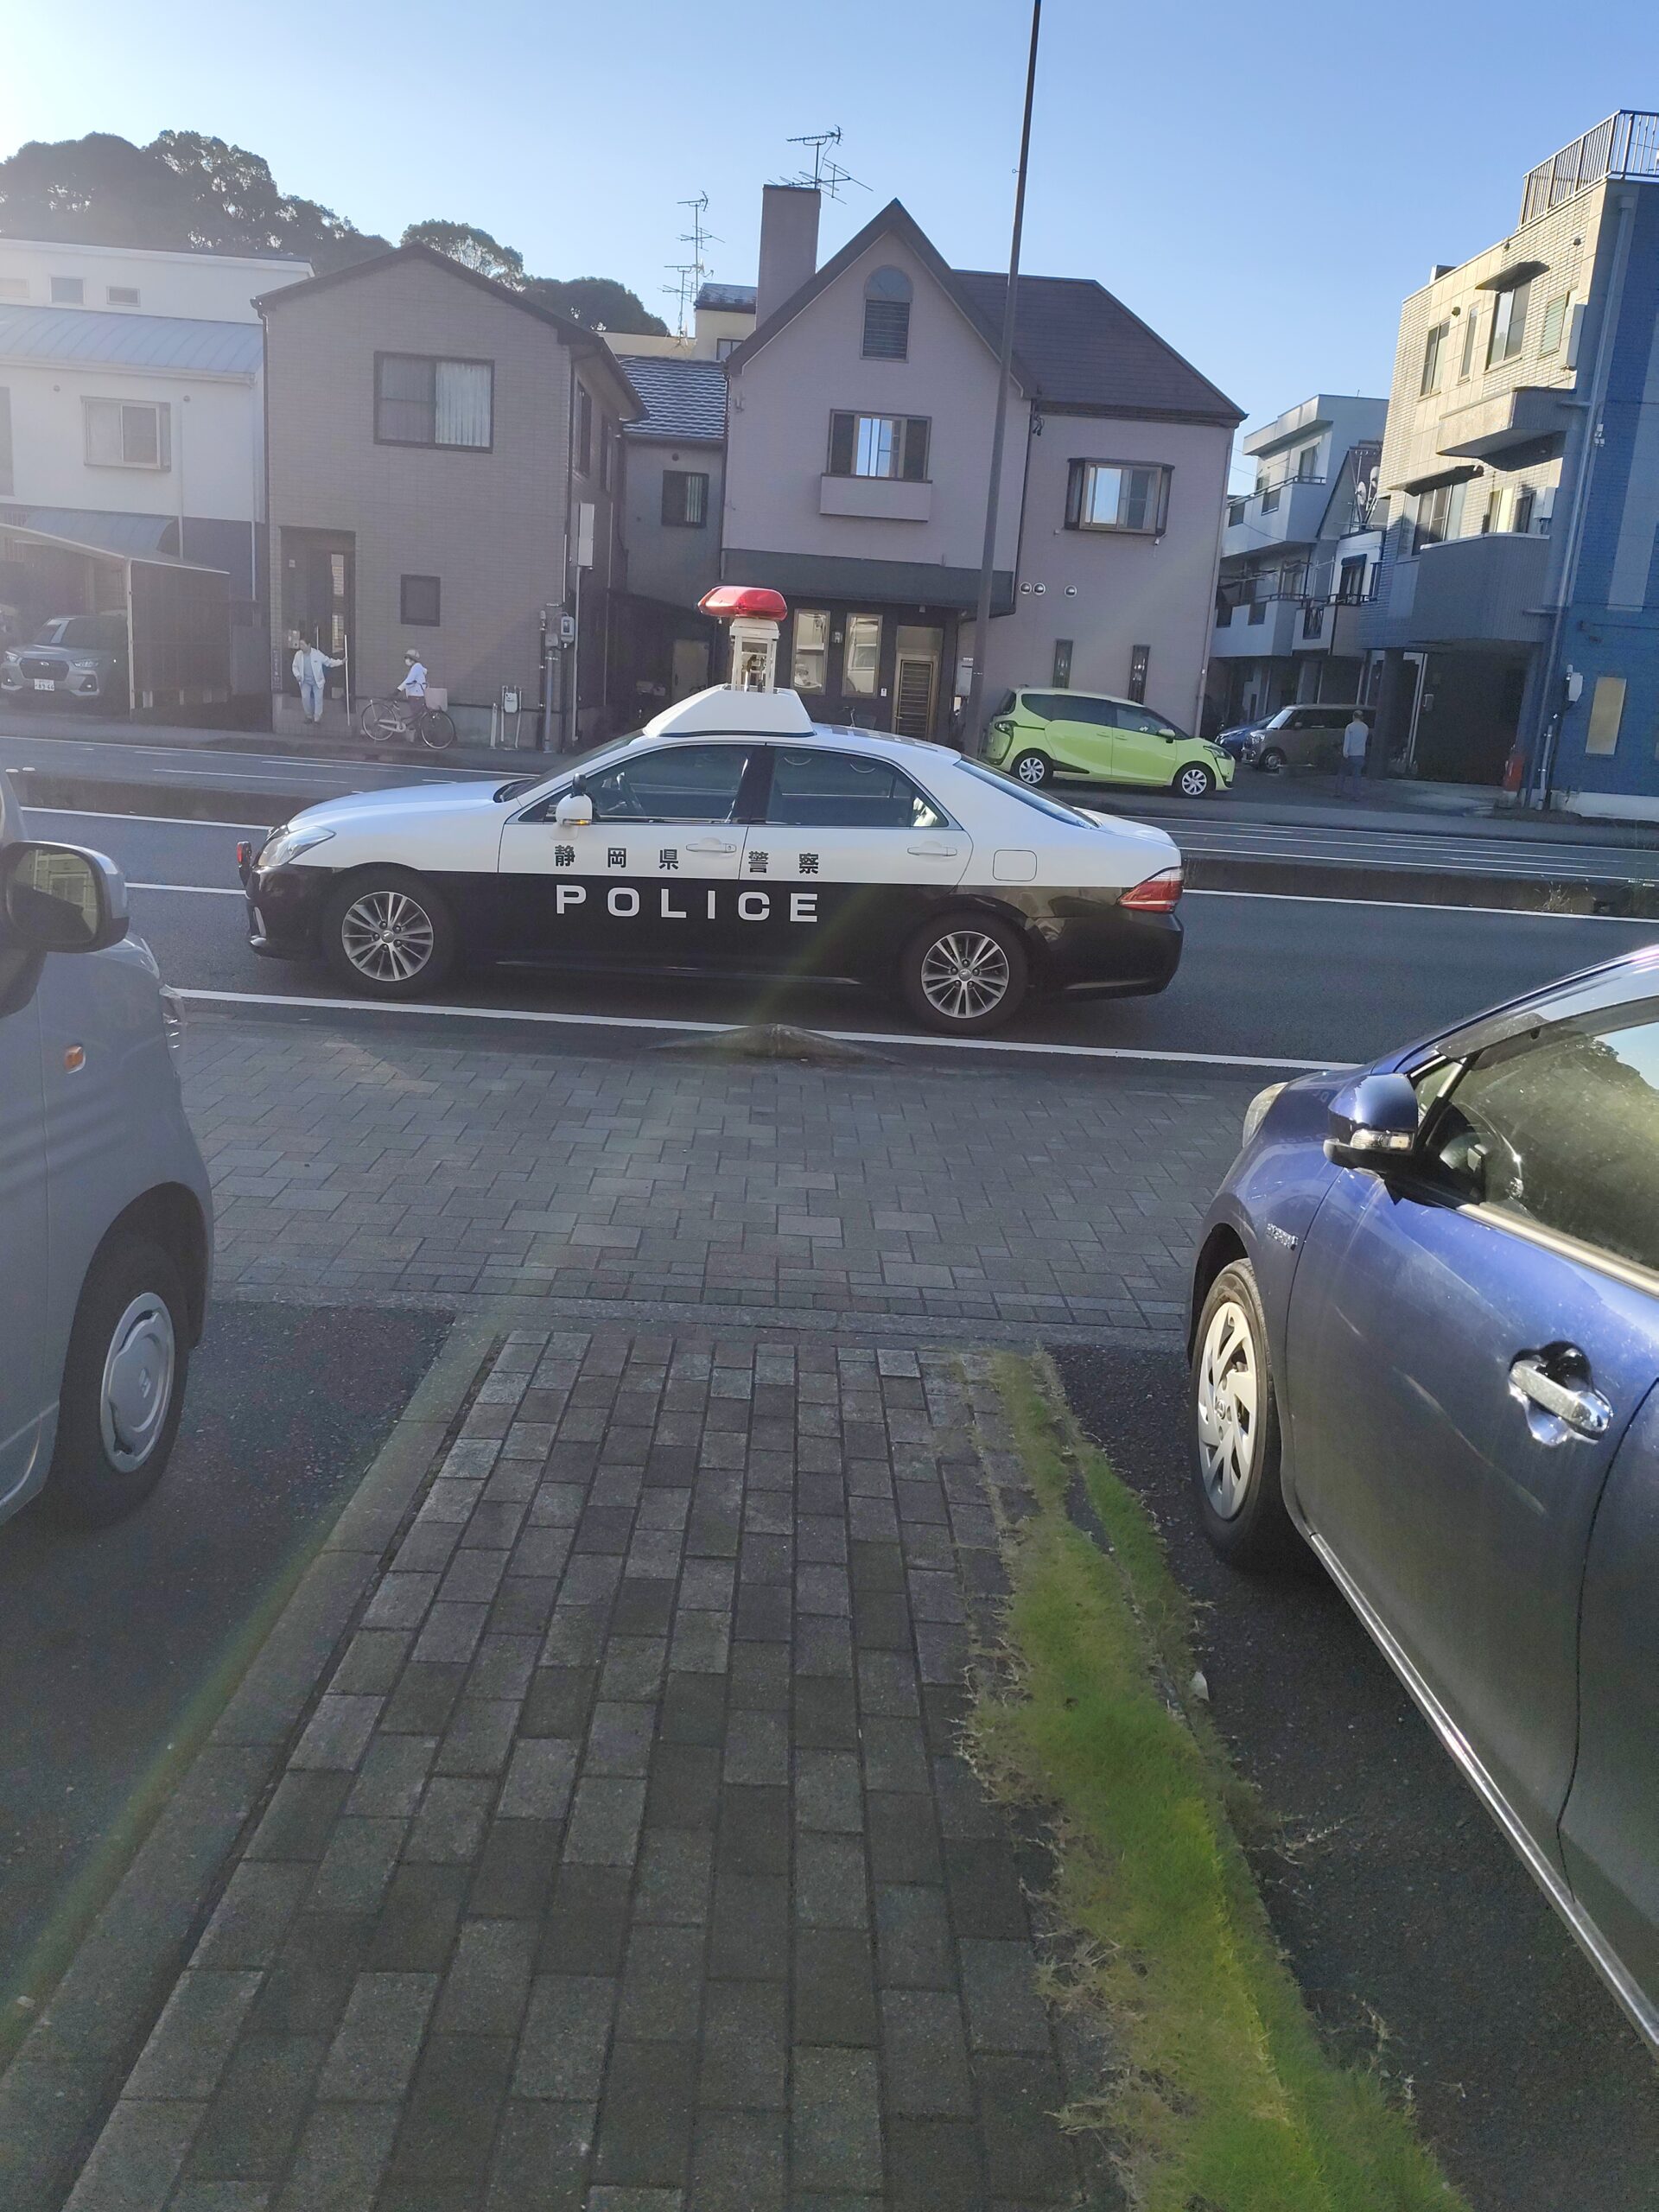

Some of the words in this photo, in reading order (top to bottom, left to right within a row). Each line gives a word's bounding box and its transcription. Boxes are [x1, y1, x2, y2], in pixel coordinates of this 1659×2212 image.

[554, 845, 819, 874] 静岡県警察
[556, 885, 818, 922] POLICE
